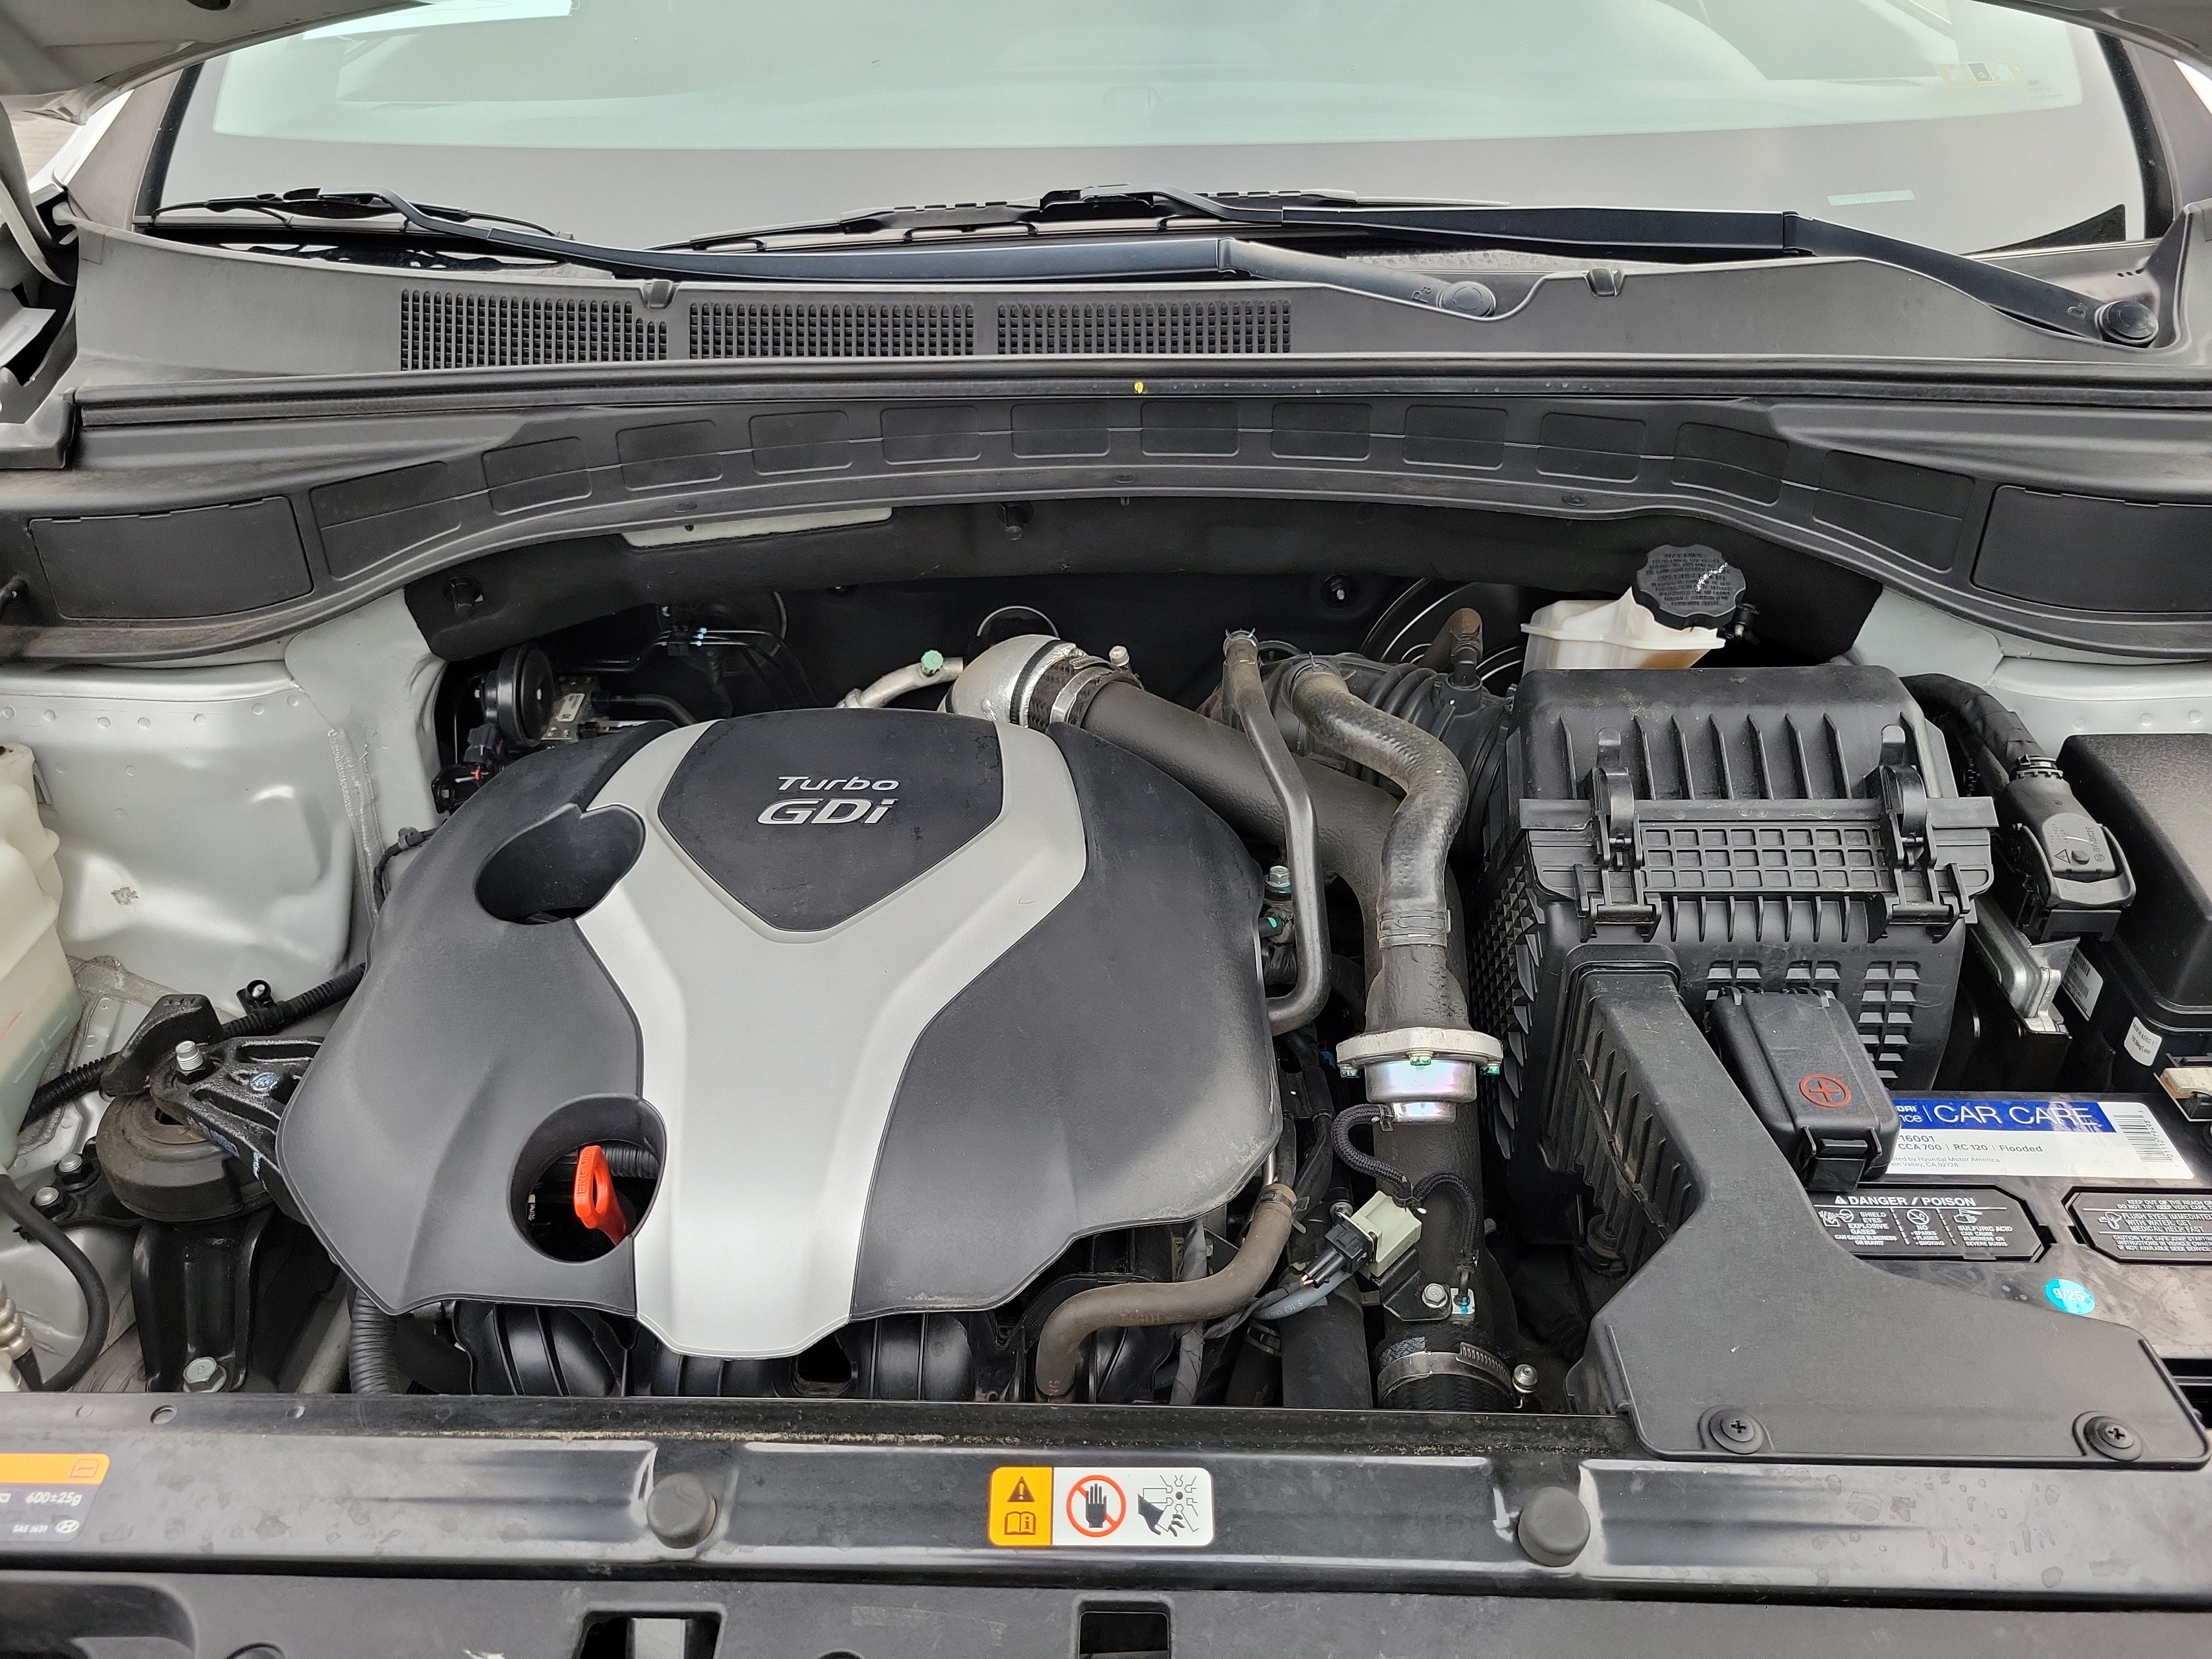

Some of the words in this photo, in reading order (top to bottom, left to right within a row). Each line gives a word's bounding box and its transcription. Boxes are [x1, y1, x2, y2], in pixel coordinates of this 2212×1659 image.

[778, 776, 900, 791] Turbo
[757, 798, 899, 824] GDi
[2086, 827, 2101, 852] BOSCH
[1898, 1114, 1923, 1122] nce
[1934, 1105, 2002, 1124] CAR
[1847, 1196, 1908, 1205] DANGER
[1921, 1197, 1977, 1206] POISON
